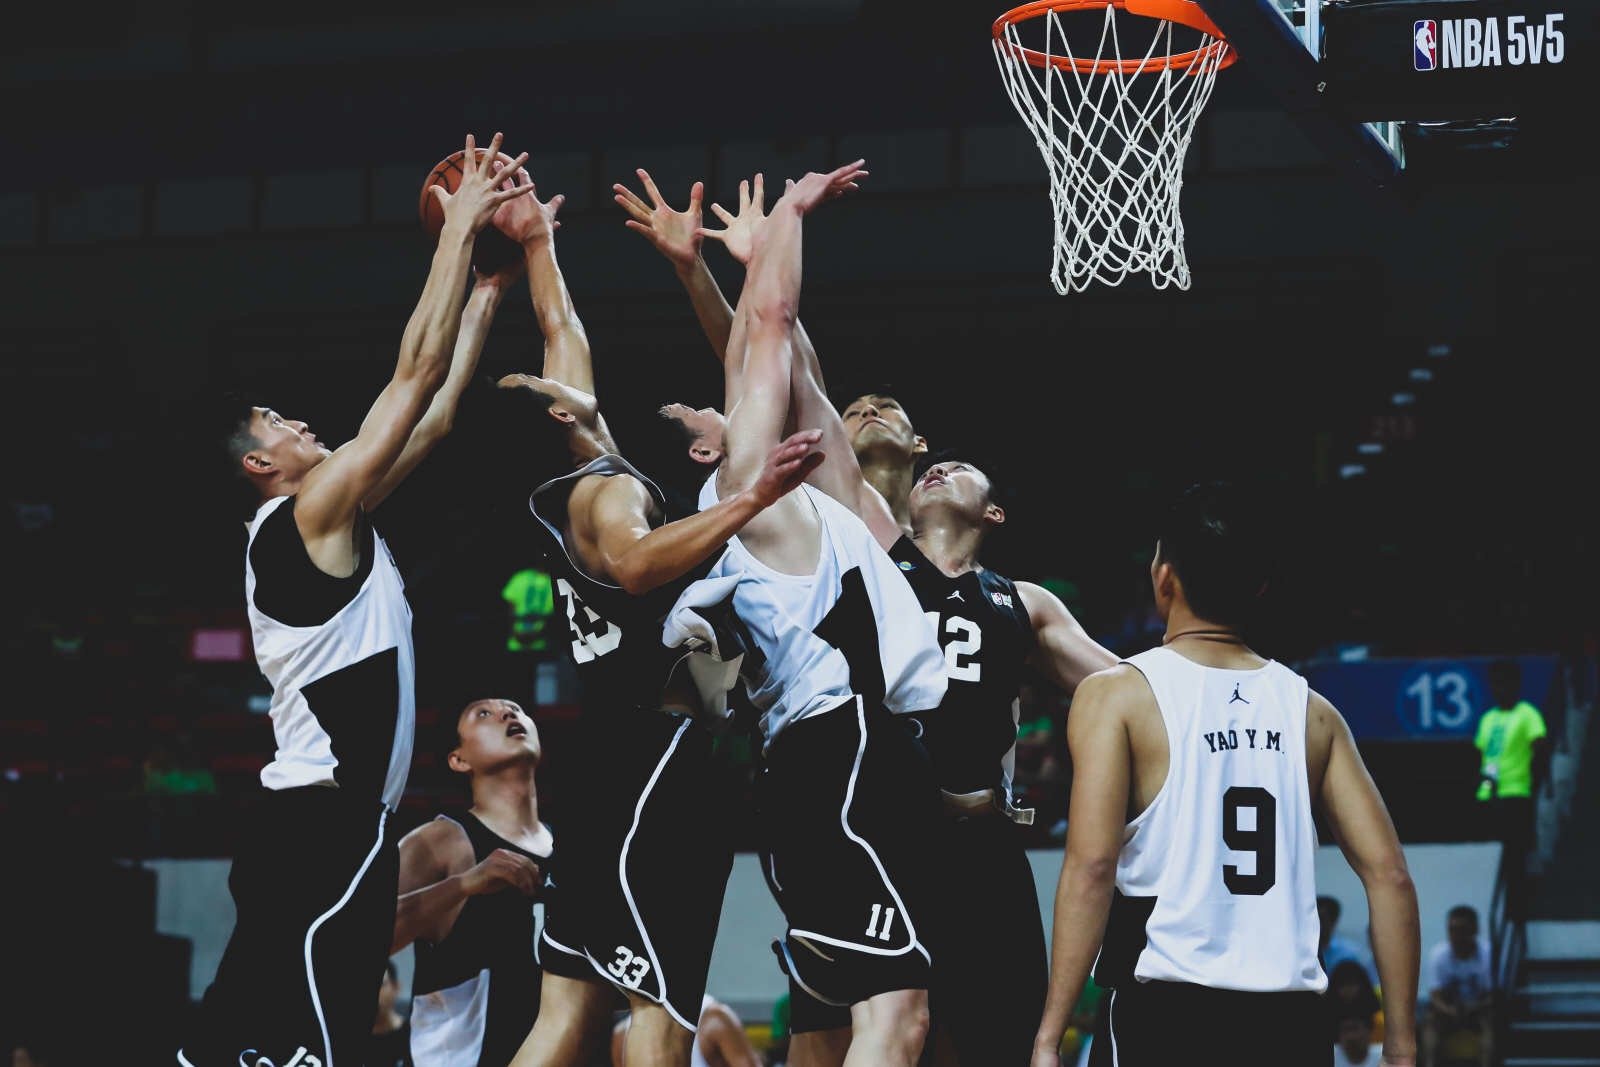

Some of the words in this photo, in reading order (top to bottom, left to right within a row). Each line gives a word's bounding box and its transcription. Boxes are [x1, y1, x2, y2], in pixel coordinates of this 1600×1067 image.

[1442, 17, 1502, 69] NBA
[1507, 13, 1565, 66] 5v5
[1406, 671, 1471, 729] 13
[1203, 729, 1239, 753] YAO
[1222, 786, 1277, 896] 9
[865, 903, 895, 941] 11
[607, 945, 651, 989] 33
